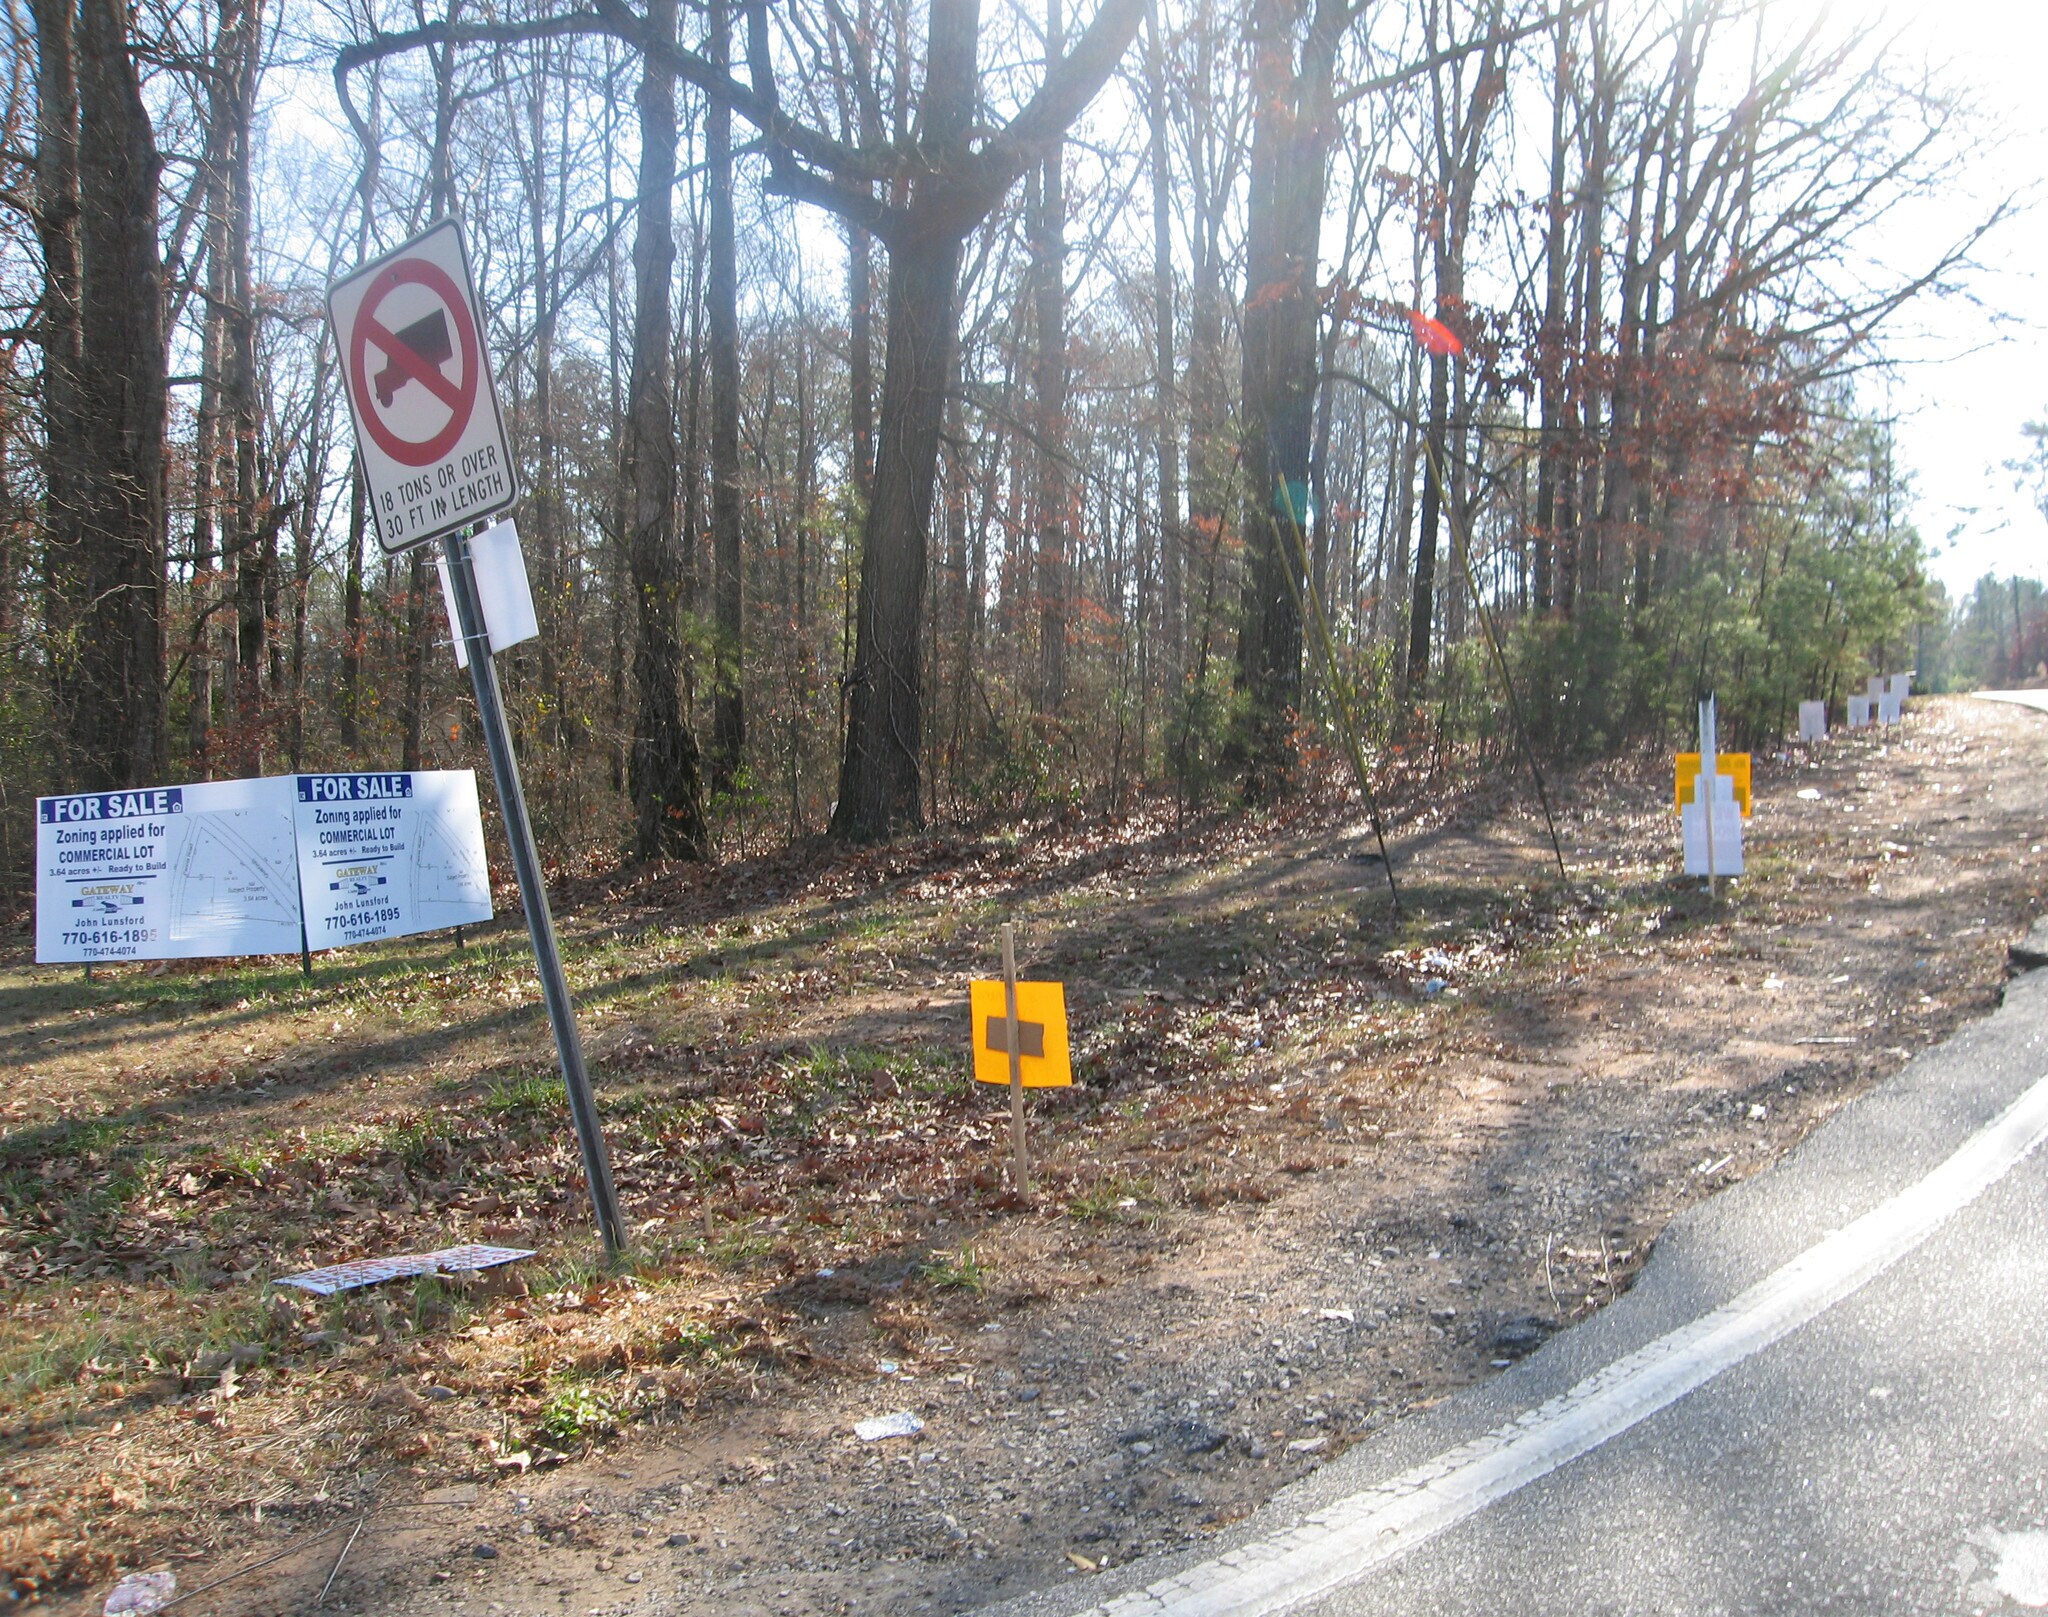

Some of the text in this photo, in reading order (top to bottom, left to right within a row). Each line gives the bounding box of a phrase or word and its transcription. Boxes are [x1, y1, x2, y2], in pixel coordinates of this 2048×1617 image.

[380, 444, 497, 513] 18 TONS OR OVER
[386, 471, 504, 539] 30 FT IN LENGTH
[311, 776, 403, 800] FOR SALE
[55, 792, 168, 821] FOR SALE
[315, 805, 402, 826] Zoning applied for
[57, 823, 165, 845] Zoning applied for
[319, 827, 395, 844] COMMERCIAL LOT
[59, 845, 154, 863] COMMERCIAL LOT
[312, 850, 327, 859] 3.64
[329, 849, 347, 857] acres
[361, 846, 380, 854] Ready
[390, 843, 405, 851] Build
[49, 868, 66, 877] 3.64
[108, 865, 133, 874] Ready
[146, 862, 166, 870] Build
[336, 865, 378, 878] GATEWAY
[81, 884, 135, 895] GATEWAY
[334, 895, 389, 911] John Lunsford
[75, 916, 145, 927] John Lunsford
[325, 907, 400, 930] 770-616-1895
[62, 928, 158, 945] 770-616-1895
[344, 925, 386, 940] 770-474-4074
[83, 946, 136, 957] 770-474-4074
